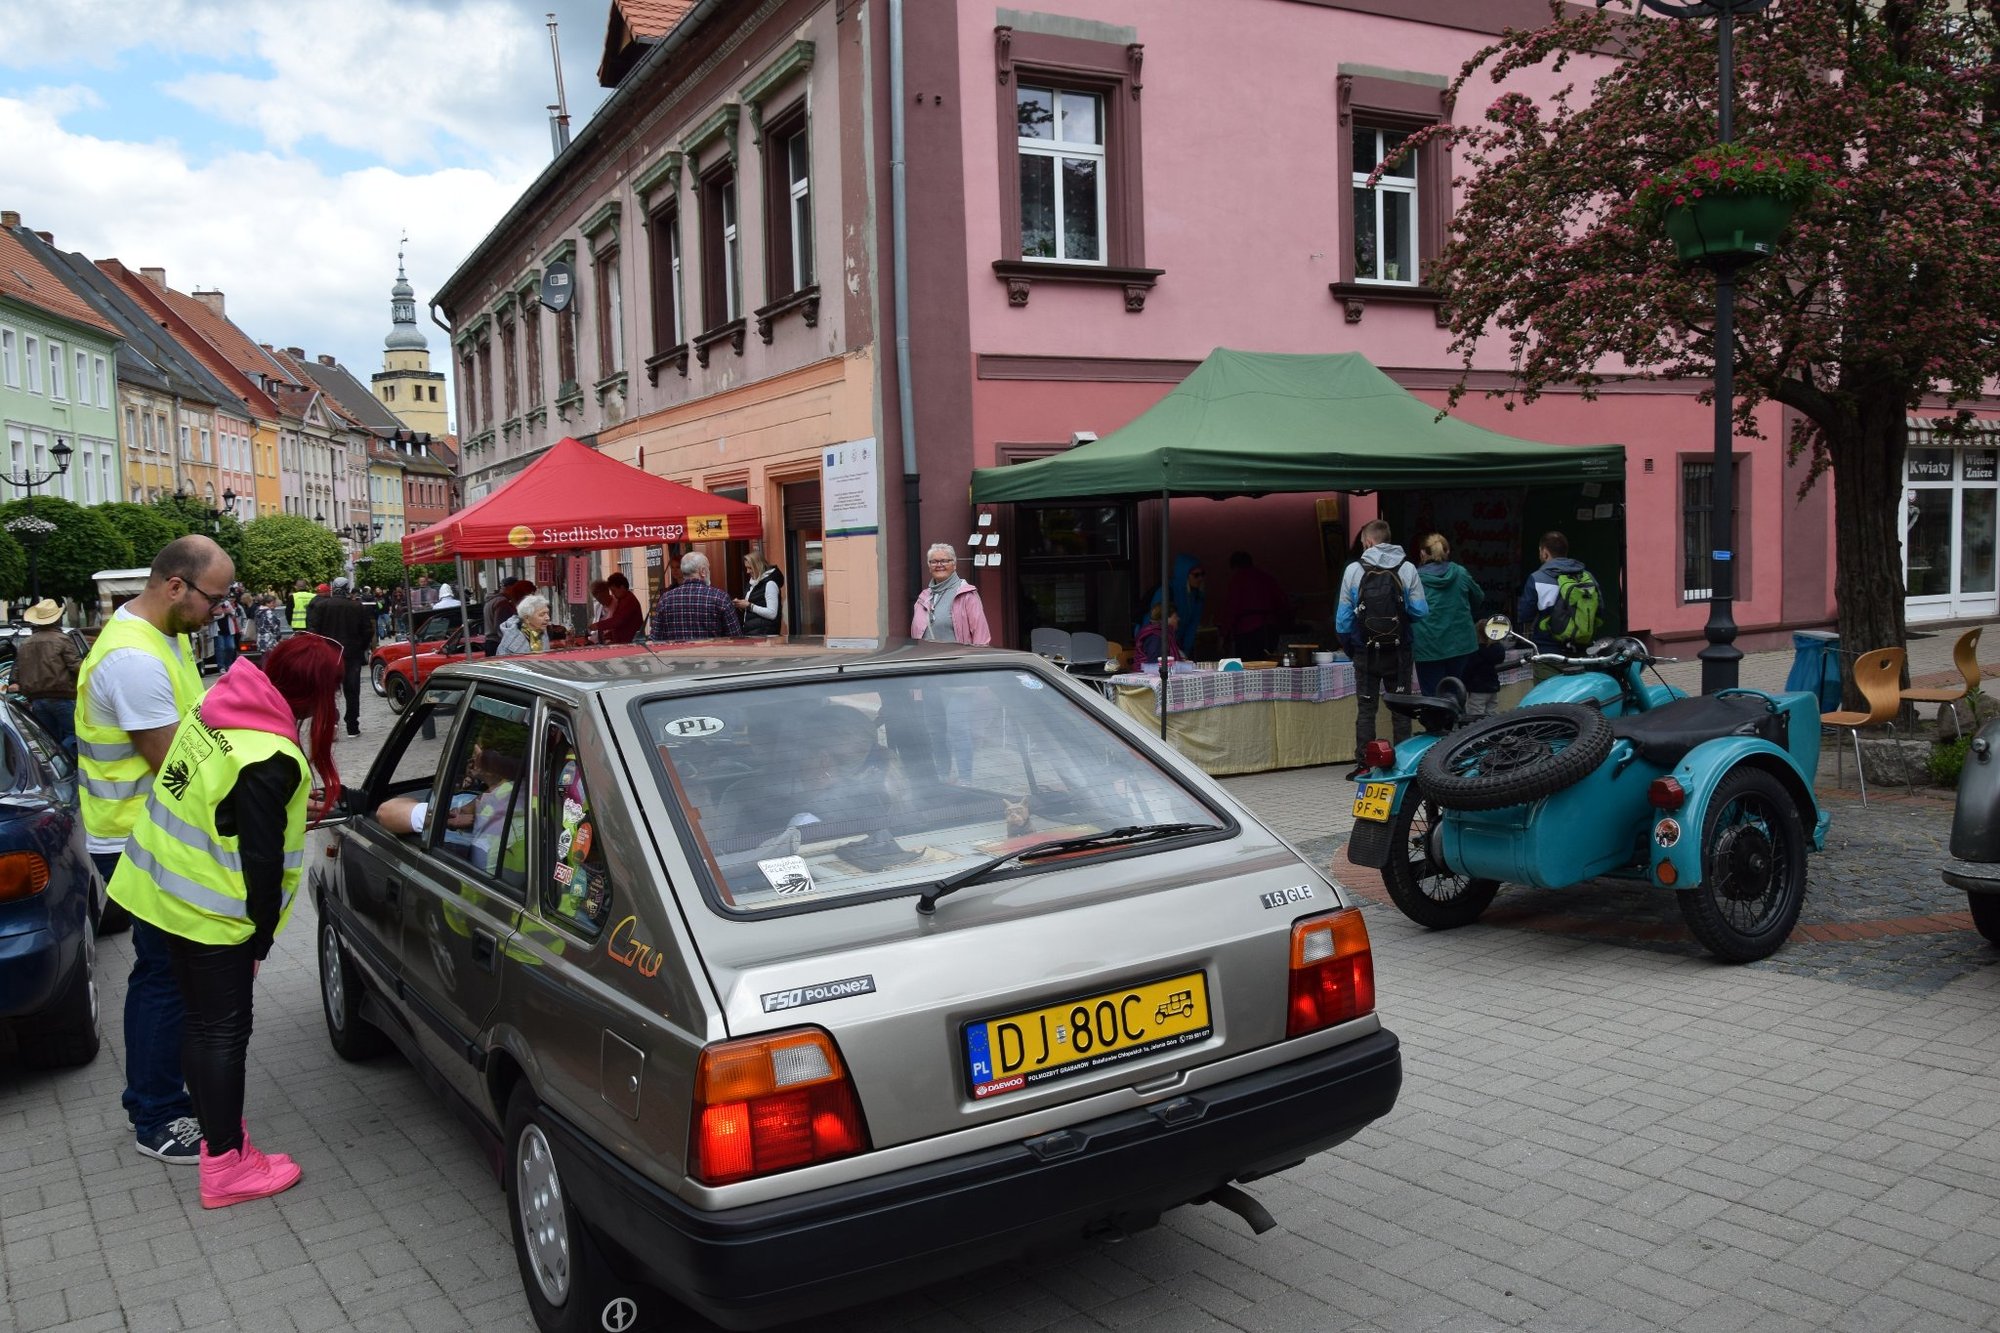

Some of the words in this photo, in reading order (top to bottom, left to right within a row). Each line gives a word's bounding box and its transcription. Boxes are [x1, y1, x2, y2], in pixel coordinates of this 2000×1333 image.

[1909, 461, 1950, 476] Kwiaty
[1966, 467, 1993, 478] Znicze
[542, 524, 619, 543] Siedlisko
[623, 523, 684, 540] Pstrąga
[676, 718, 717, 734] PL
[1365, 785, 1389, 800] DJE
[1356, 801, 1372, 815] 9F
[1265, 892, 1284, 907] 1.6
[1286, 885, 1313, 902] GLE
[765, 989, 802, 1011] FSO
[997, 1014, 1049, 1073] DJ
[973, 1061, 990, 1077] PL
[987, 1077, 1023, 1092] DAEWOO
